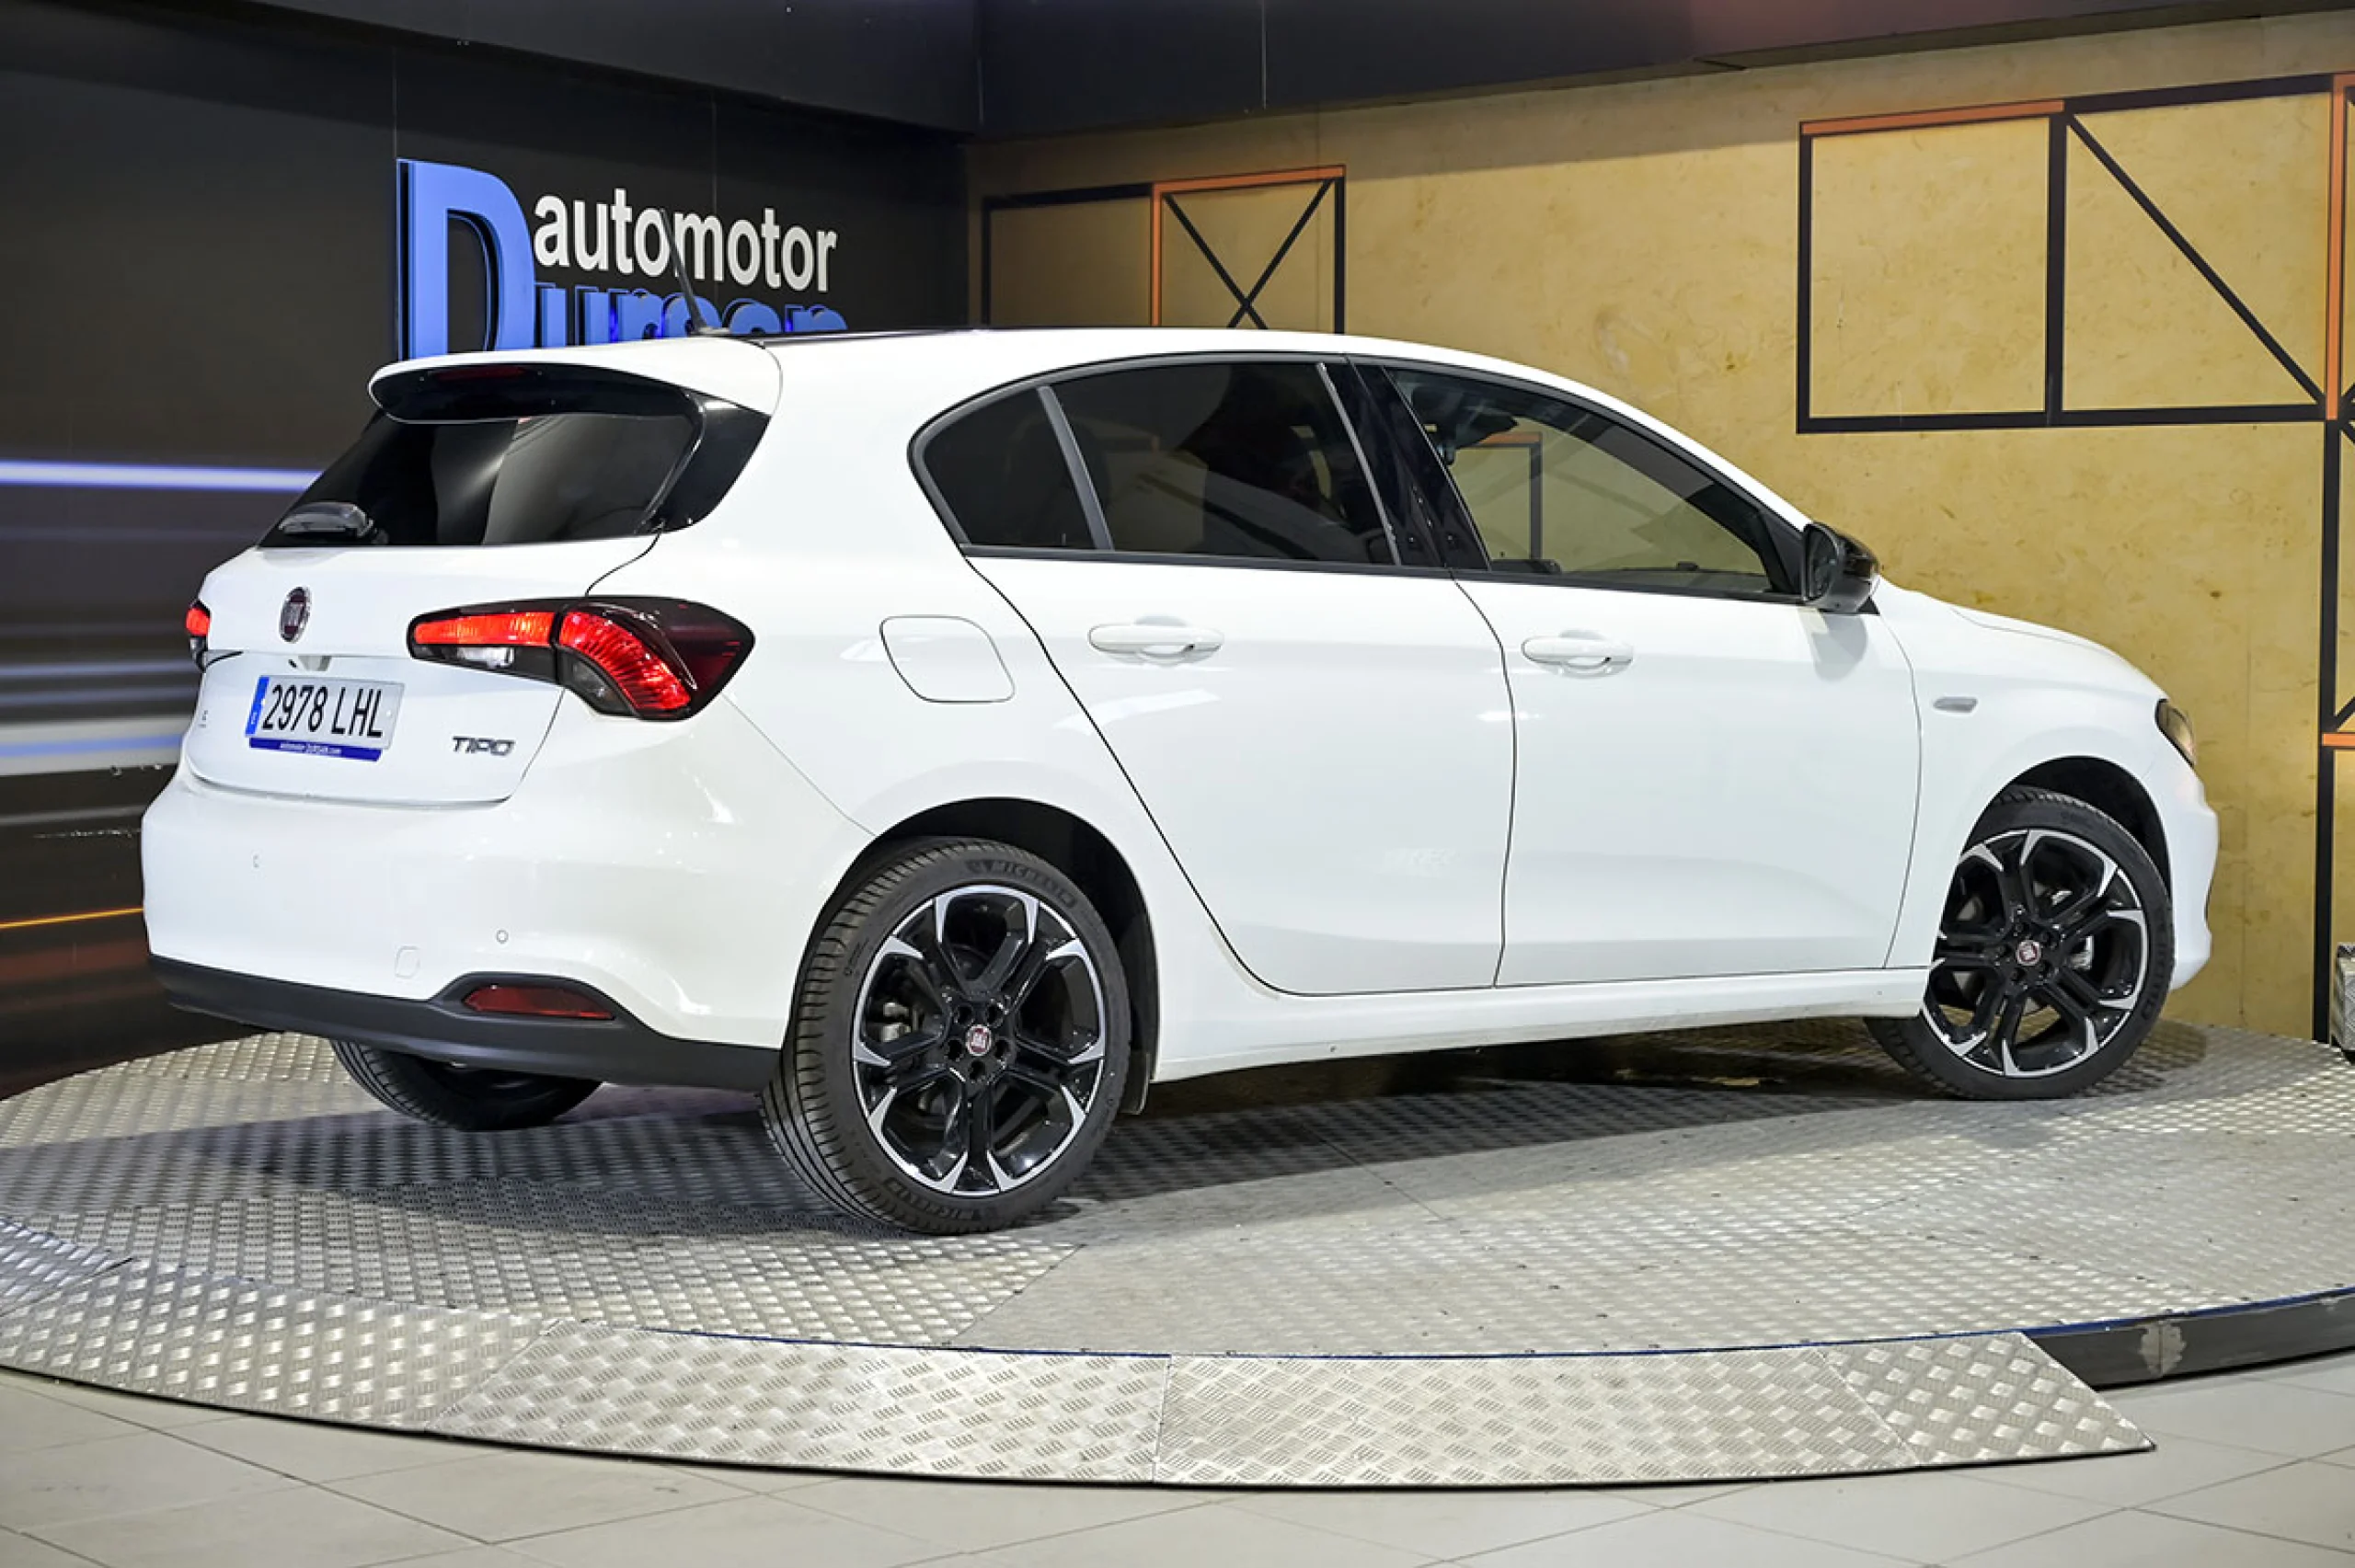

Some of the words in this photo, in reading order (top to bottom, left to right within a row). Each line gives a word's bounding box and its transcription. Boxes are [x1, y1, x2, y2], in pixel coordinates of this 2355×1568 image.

[534, 189, 837, 292] automotor
[262, 684, 327, 733] 2978
[330, 687, 384, 738] LHL
[453, 735, 516, 756] TIPO
